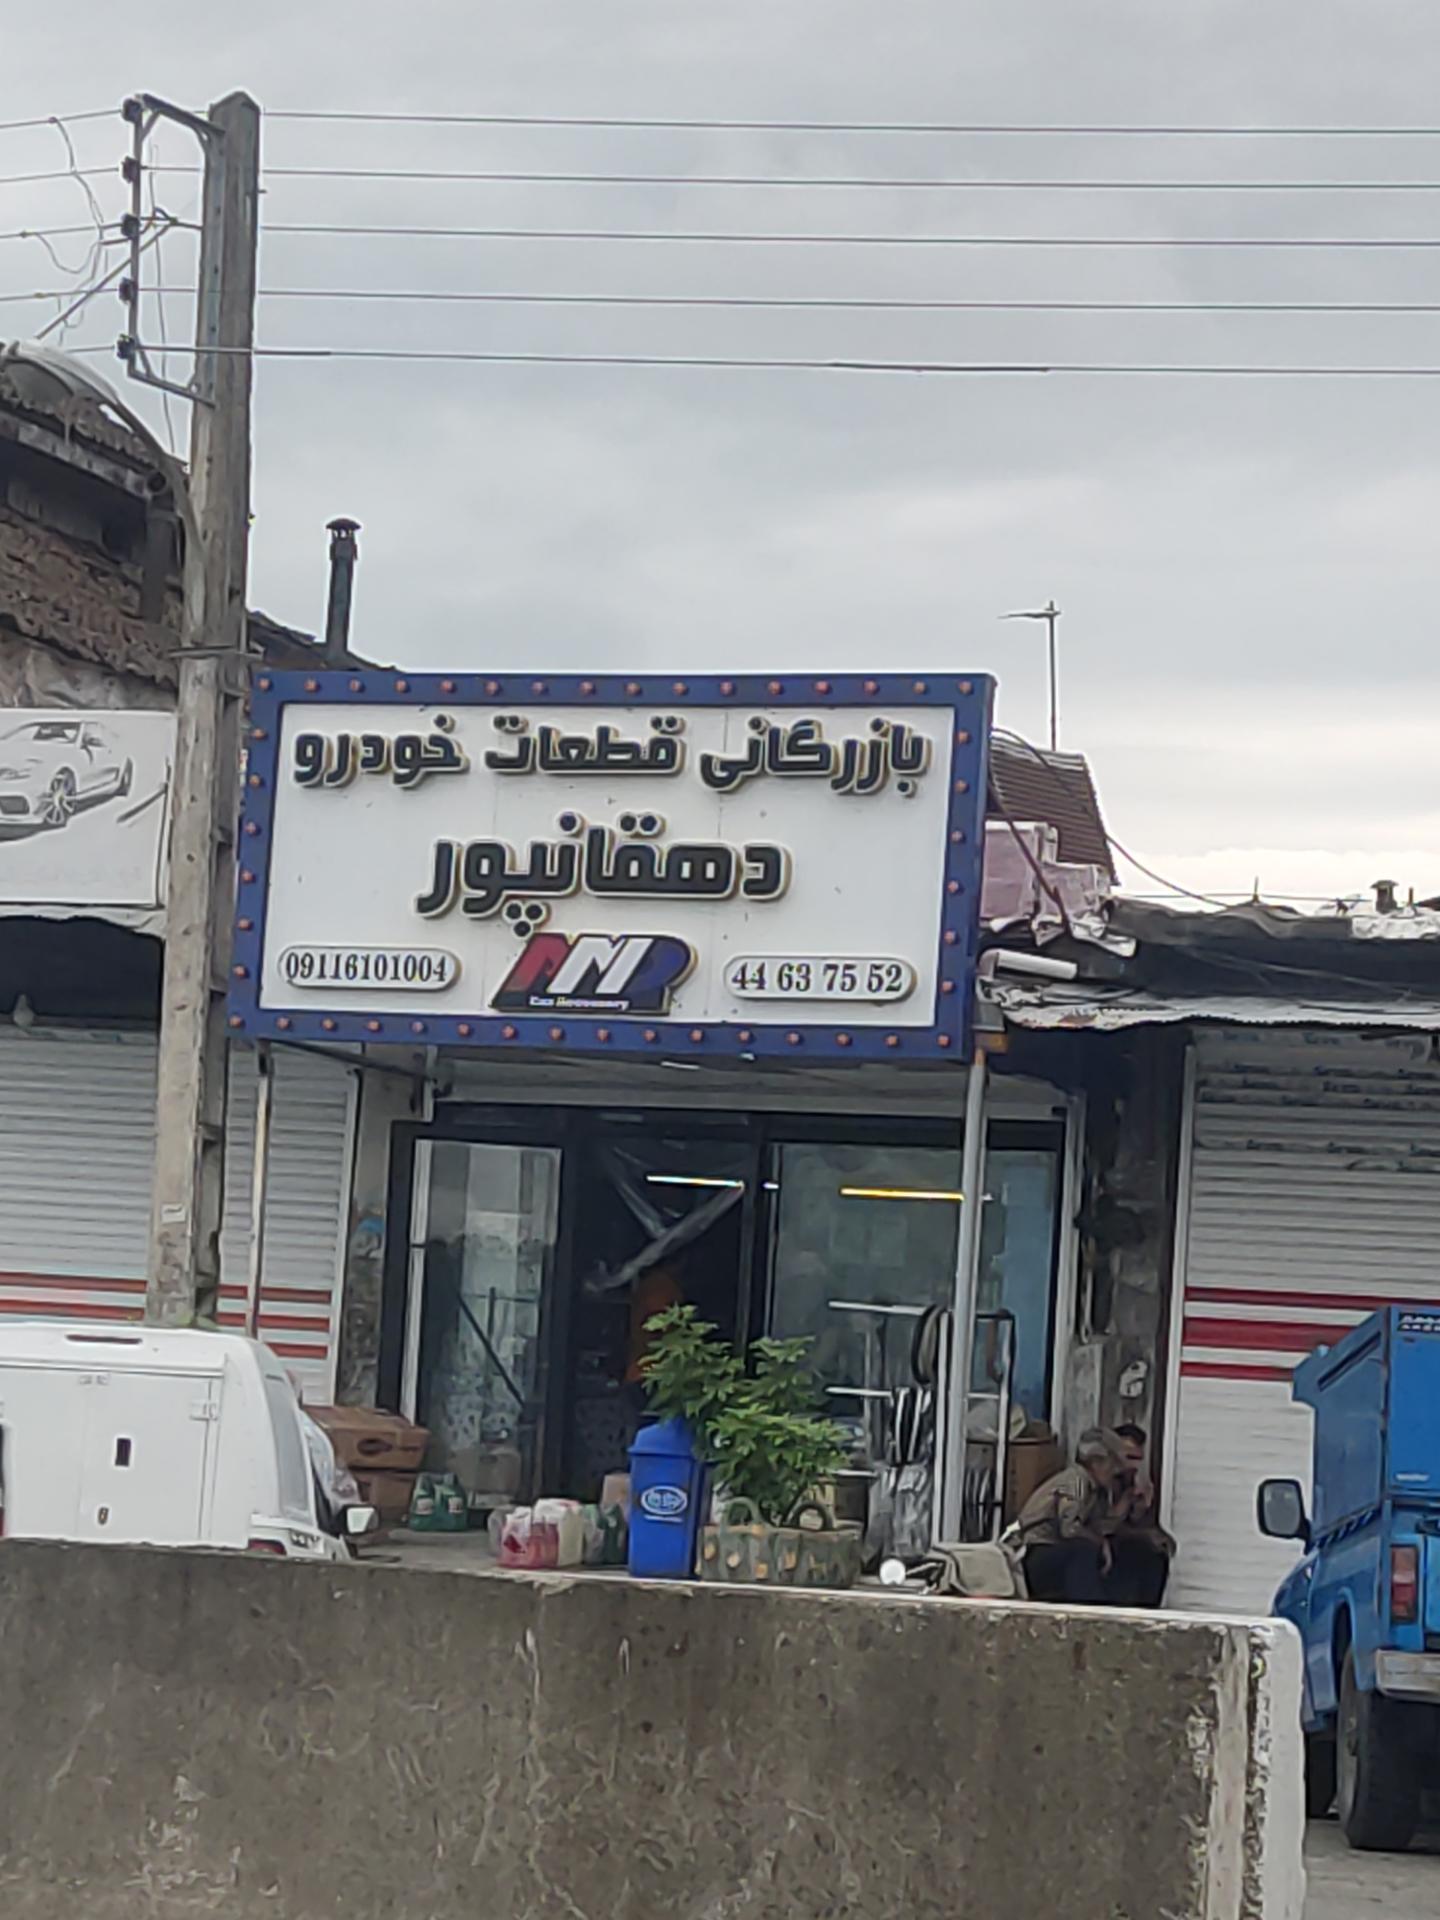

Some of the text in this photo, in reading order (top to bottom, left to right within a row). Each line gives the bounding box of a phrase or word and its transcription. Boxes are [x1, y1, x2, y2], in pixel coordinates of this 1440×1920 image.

[293, 714, 929, 793] بازرگانی قطعات خودرو
[415, 813, 788, 938] دهقانپور
[285, 951, 447, 983] 09116101004
[731, 961, 903, 993] 44 63 75 52
